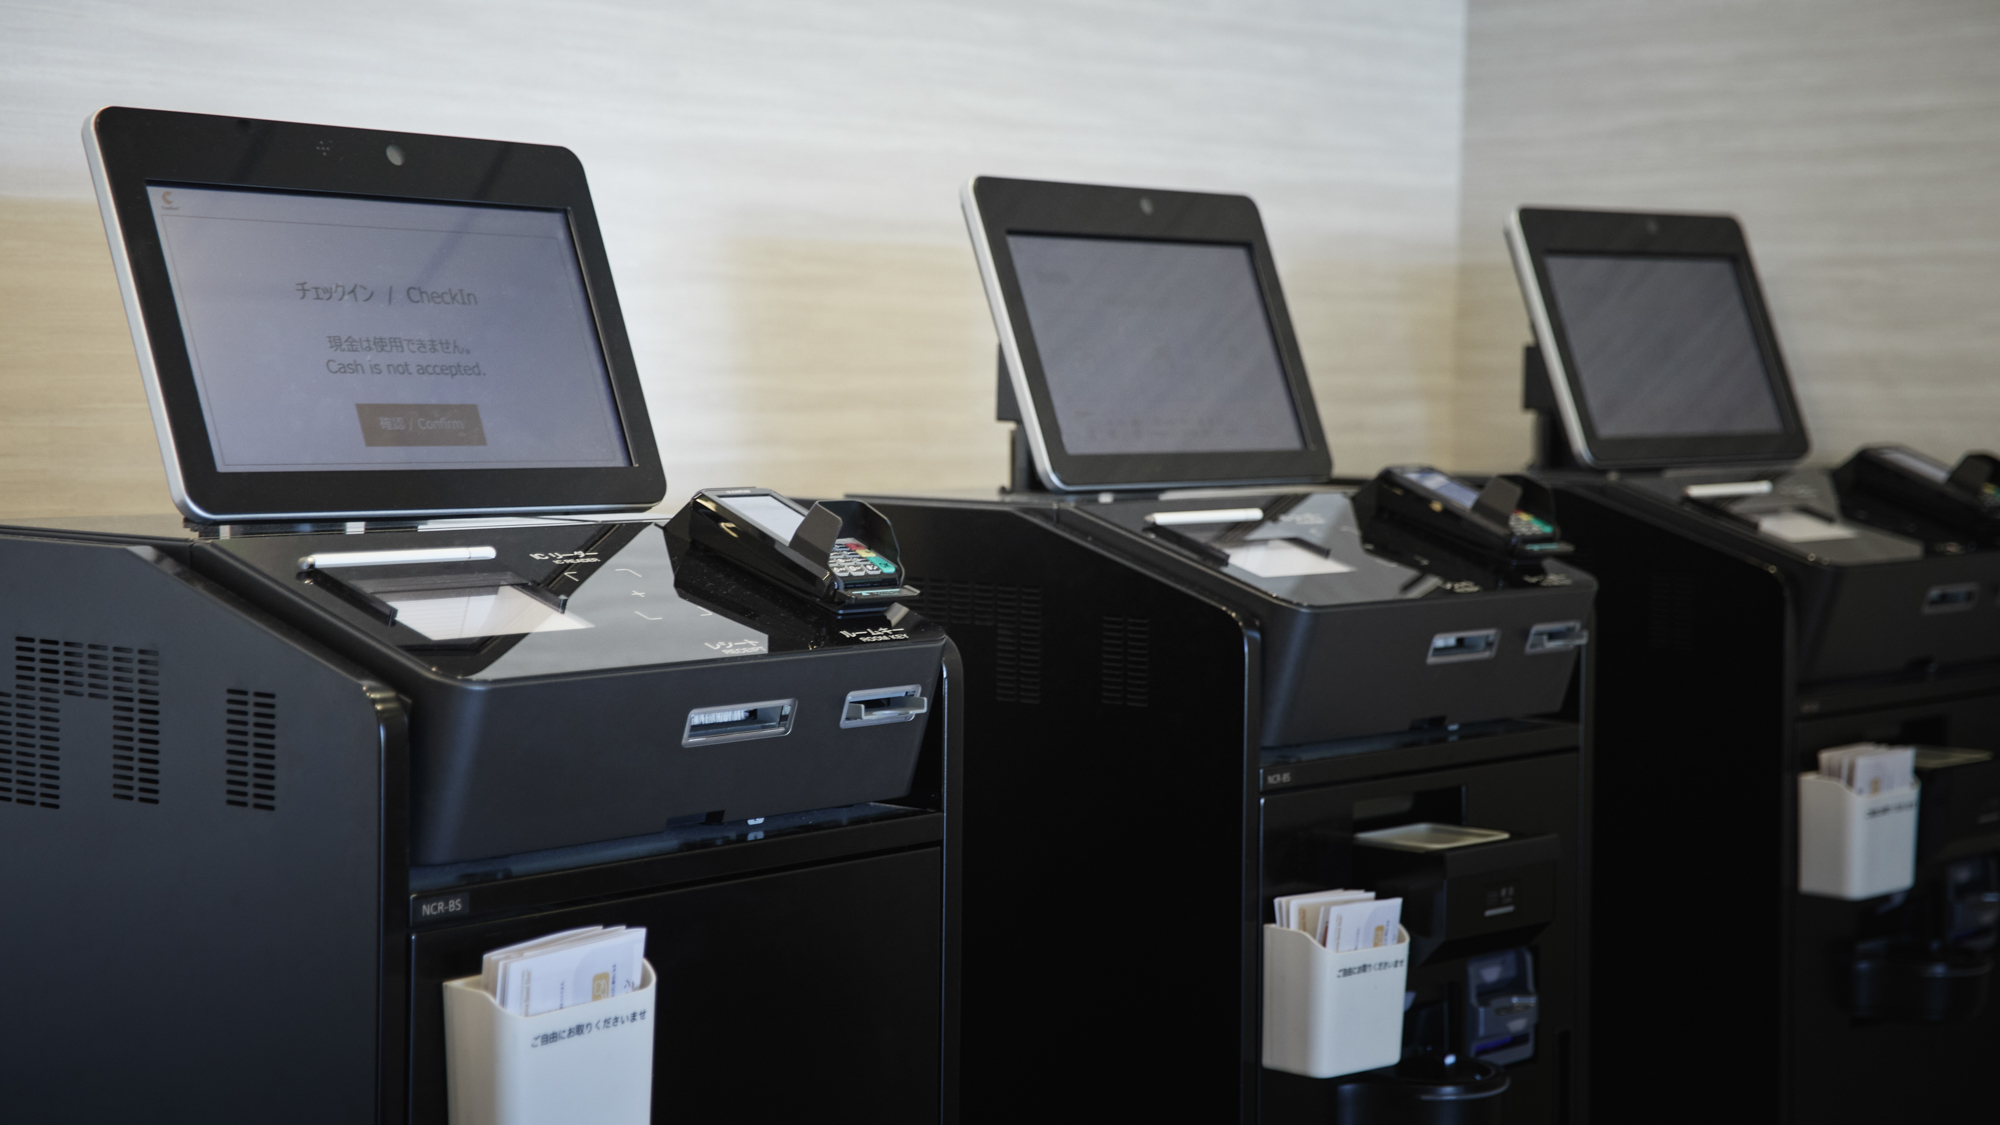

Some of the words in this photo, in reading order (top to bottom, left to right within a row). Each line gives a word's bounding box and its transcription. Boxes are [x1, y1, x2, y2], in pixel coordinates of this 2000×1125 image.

[295, 282, 374, 302] チェックイン
[406, 286, 478, 305] CheckIn
[326, 336, 471, 355] 現金は使用できません。
[326, 359, 365, 375] Cash
[370, 360, 382, 375] is
[387, 362, 412, 375] not
[416, 362, 486, 378] accepted.
[380, 417, 405, 431] 確認
[418, 417, 464, 430] Confirm
[839, 627, 904, 638] ルームキー
[704, 639, 759, 650] レシート
[421, 898, 462, 916] NCR-BS
[531, 1009, 647, 1048] ご自由にお取りくださいませ
